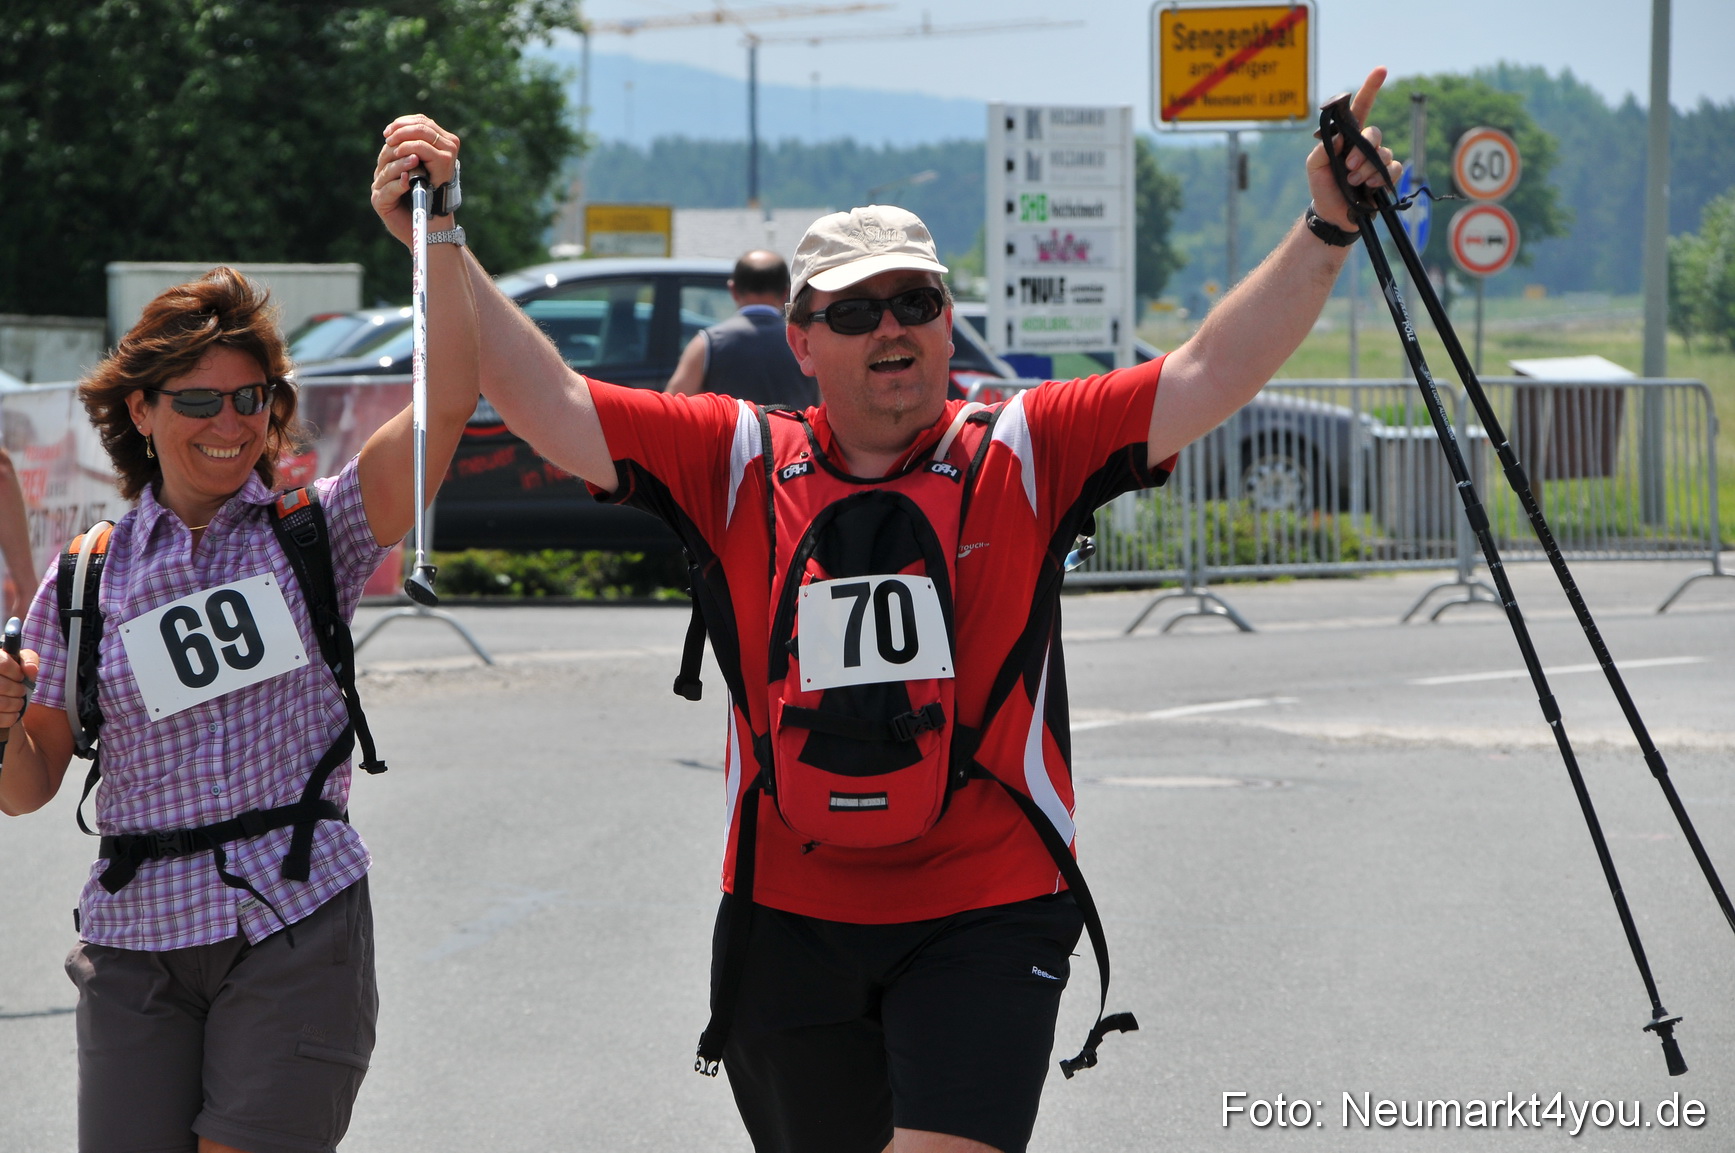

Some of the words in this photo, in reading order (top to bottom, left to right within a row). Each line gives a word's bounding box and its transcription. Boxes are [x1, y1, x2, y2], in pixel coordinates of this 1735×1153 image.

[1172, 20, 1296, 58] Sengenthal
[1470, 150, 1505, 181] 60
[1402, 320, 1416, 342] POLE
[159, 588, 266, 689] 69
[830, 579, 919, 668] 70
